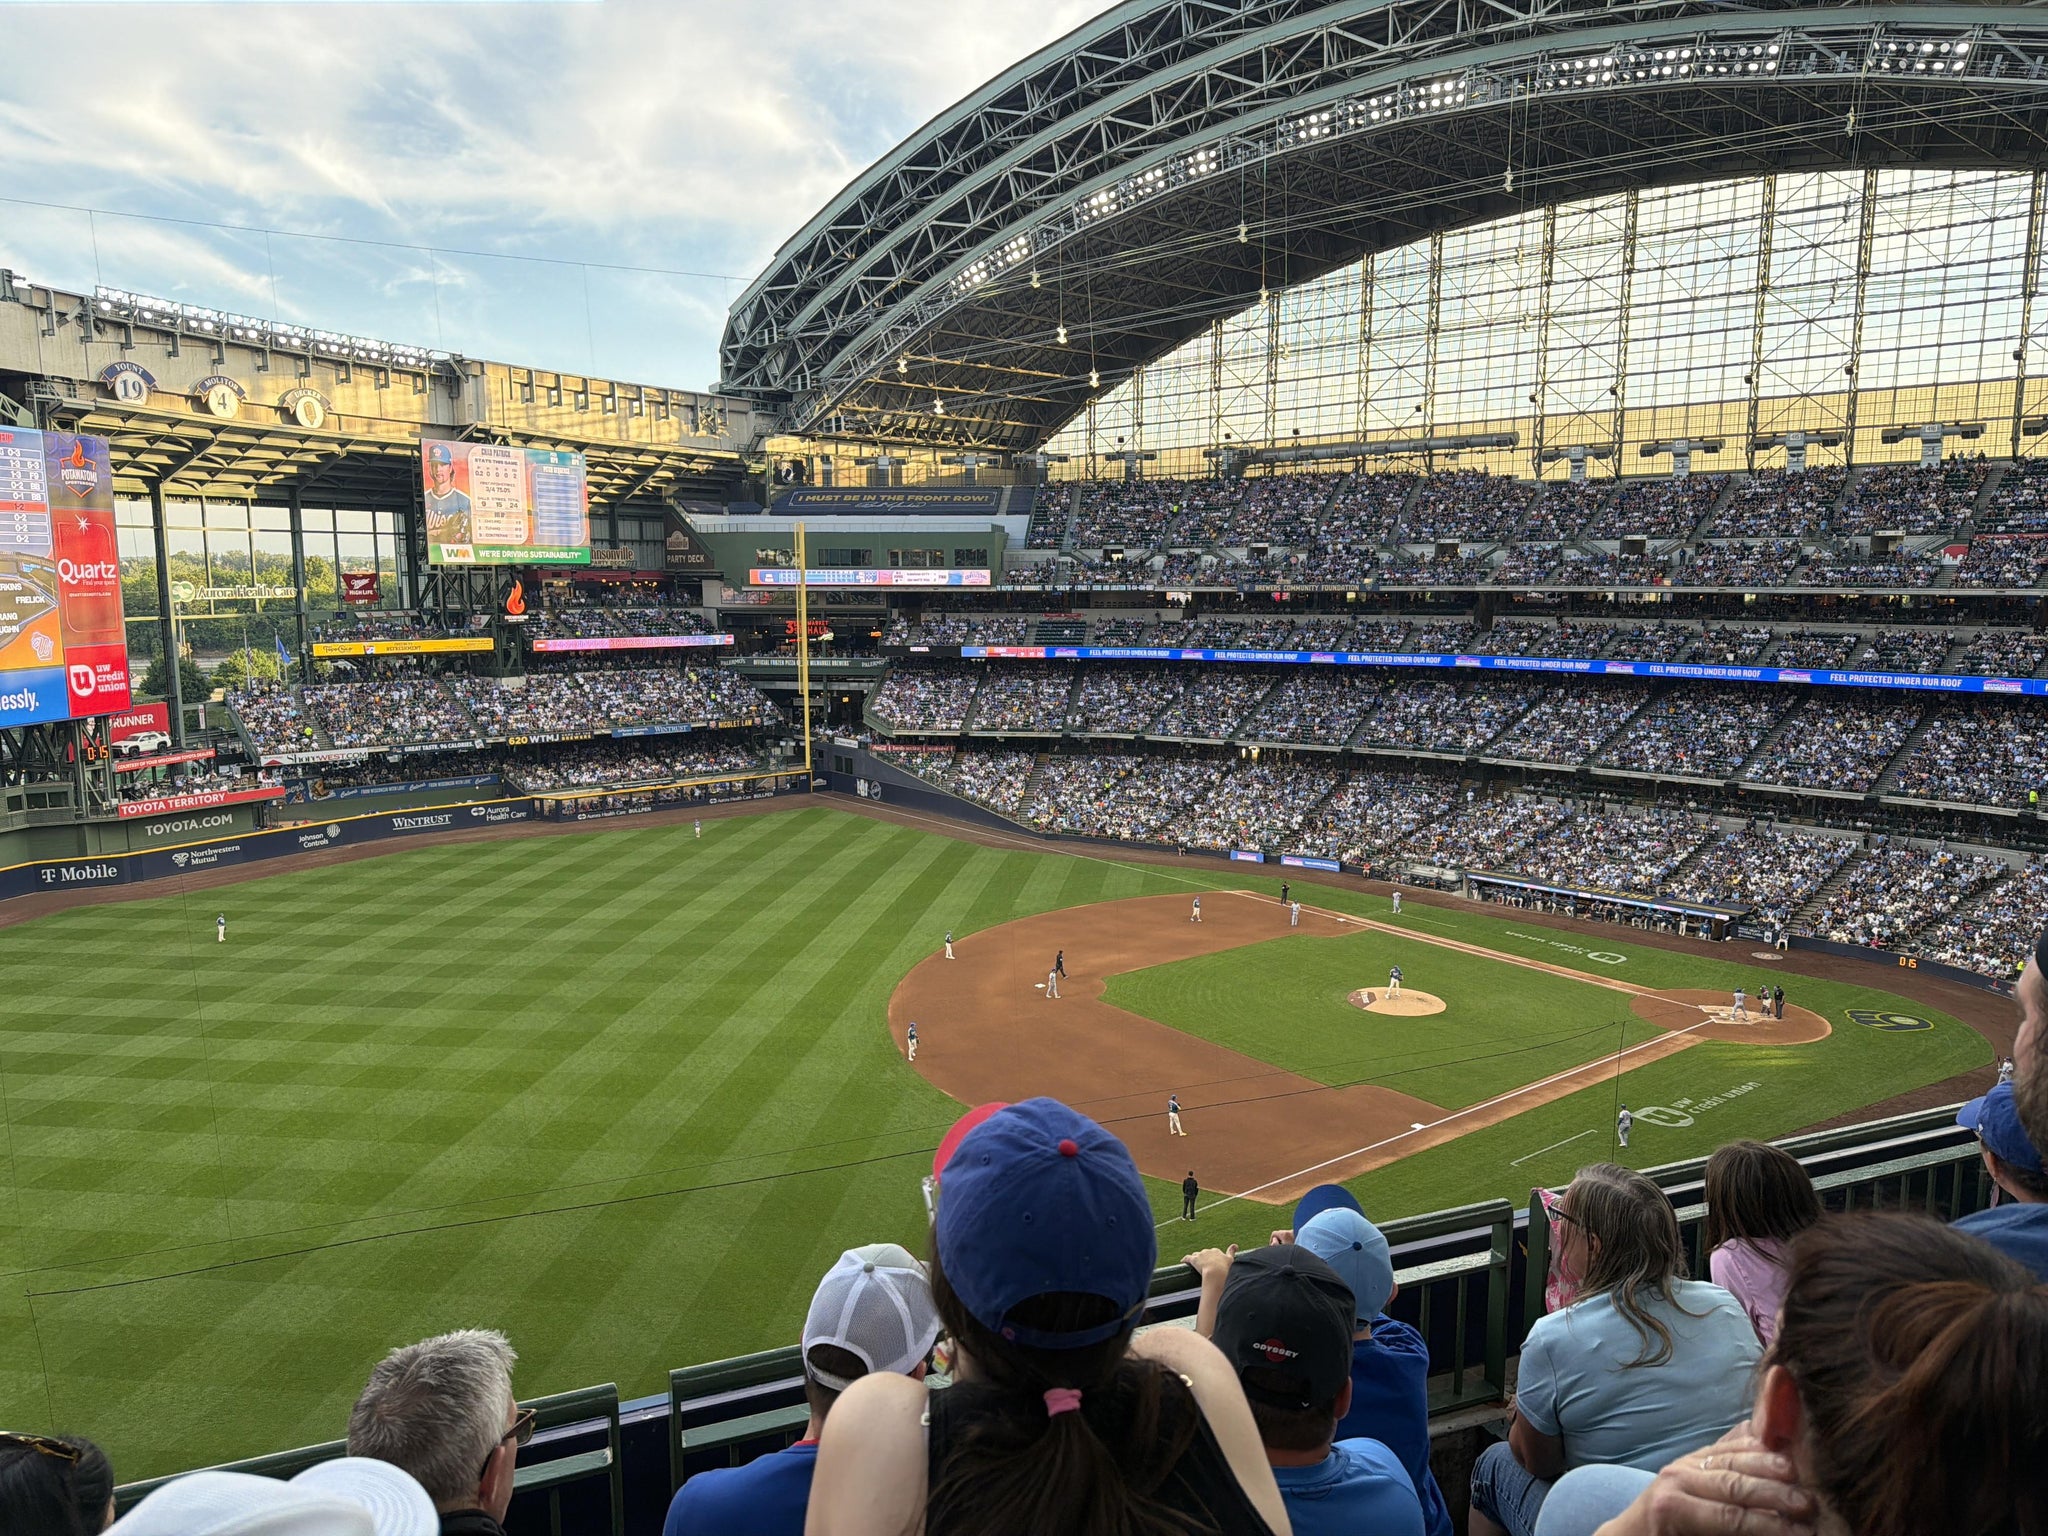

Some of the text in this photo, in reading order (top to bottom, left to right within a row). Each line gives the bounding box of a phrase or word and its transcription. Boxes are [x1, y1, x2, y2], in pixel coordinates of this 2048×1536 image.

[114, 363, 144, 375] YOUNT
[120, 378, 143, 399] 19
[204, 377, 239, 391] MOLITOR
[217, 392, 227, 409] 4
[14, 503, 24, 511] 1-2
[14, 513, 27, 521] 0-2
[15, 524, 28, 532] 0-2
[16, 535, 29, 543] 0-2
[446, 548, 471, 558] WM
[502, 550, 528, 558] DRIVING
[667, 554, 705, 563] PARTY DECK
[58, 558, 116, 585] Quartz
[198, 585, 297, 599] Aurora Health Care
[15, 596, 45, 604] FRELICK
[1361, 655, 1392, 663] PROTECTED
[1508, 659, 1540, 668] PROTECTED
[1562, 661, 1574, 669] OUR
[1575, 662, 1591, 670] ROOF
[96, 664, 111, 672] uw
[1650, 665, 1761, 678] FEEL PROTECTED UNDER OUR ROOF
[97, 672, 124, 682] credit
[1830, 673, 1962, 687] FEEL PROTECTED UNDER OUR ROOF
[97, 681, 126, 692] union
[654, 725, 688, 733] WINTRUST
[448, 741, 474, 749] CALORIES.
[508, 734, 559, 745] 620 WTMJ
[158, 756, 180, 764] WISCONSIN
[197, 750, 214, 758] DEALERS
[753, 791, 774, 800] BULLPEN
[121, 793, 226, 815] TOYOTA TERRITORY
[486, 806, 509, 814] Aurora
[628, 806, 652, 815] BULLPEN
[392, 814, 452, 828] WINTRUST
[486, 811, 527, 821] Health Care
[145, 814, 233, 836] TOYOTA.COM
[299, 832, 324, 843] Johnson
[303, 838, 329, 848] Controls
[190, 845, 240, 858] Northwestern
[191, 854, 218, 865] Mutual
[61, 864, 118, 882] Mobile
[1671, 1097, 1694, 1109] uw
[1688, 1081, 1763, 1114] credit union
[1253, 1342, 1299, 1359] ODYSSEY
